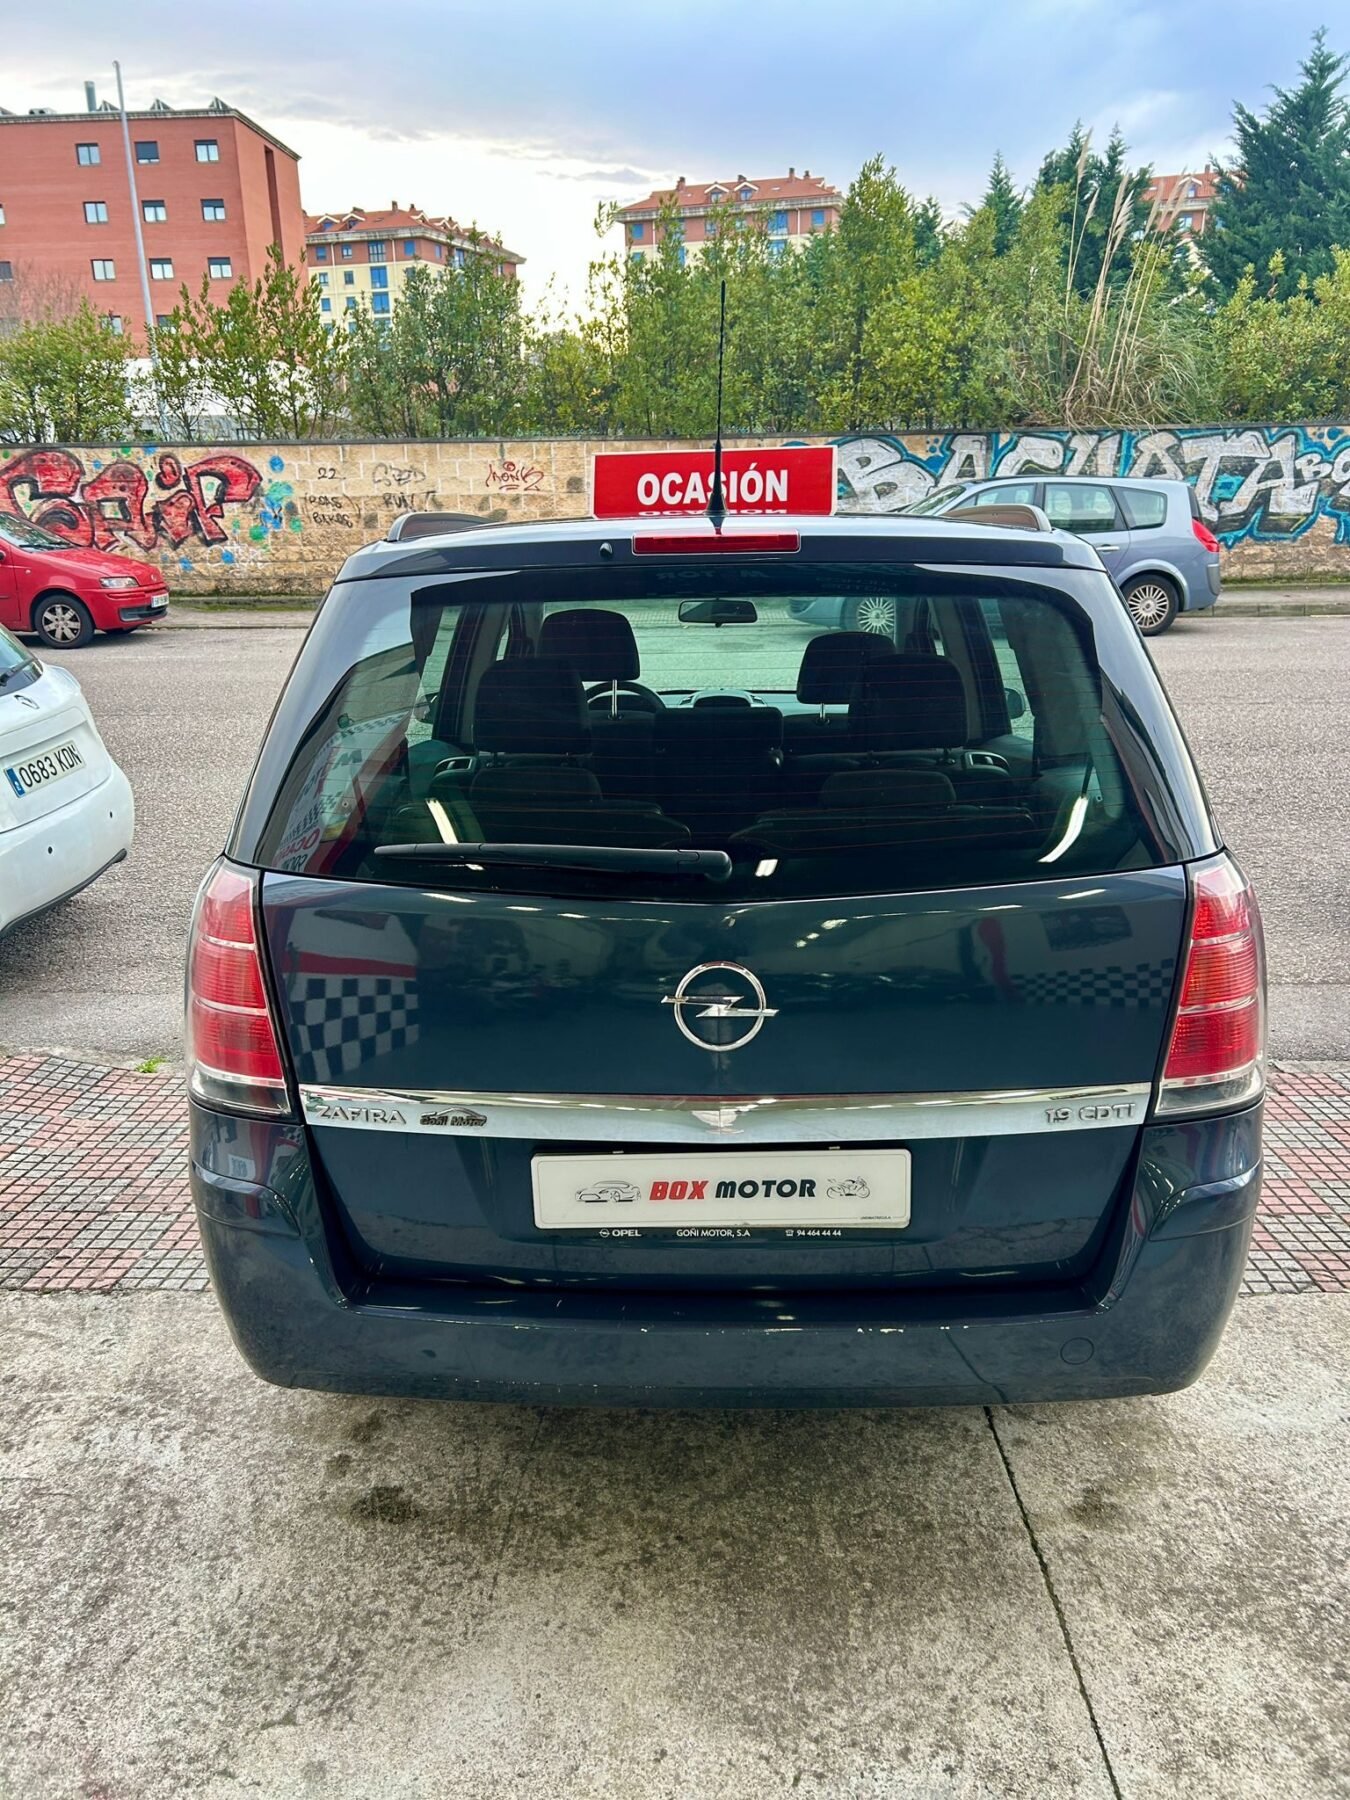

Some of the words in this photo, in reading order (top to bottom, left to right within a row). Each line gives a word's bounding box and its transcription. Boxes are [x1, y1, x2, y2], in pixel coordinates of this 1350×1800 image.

[637, 462, 788, 506] OCASIÓN
[18, 756, 58, 788] 0683
[53, 744, 82, 772] KDN
[315, 1105, 407, 1125] ZAFIRA
[1079, 1103, 1136, 1121] CDTI
[650, 1180, 708, 1200] BOX
[715, 1179, 817, 1199] MOTOR
[612, 1228, 642, 1237] OPEL
[676, 1227, 699, 1237] GOÑI
[701, 1228, 735, 1238] MOTOR,
[796, 1229, 806, 1237] 94
[806, 1229, 820, 1237] 464
[821, 1229, 831, 1237] 44
[832, 1229, 842, 1237] 44
